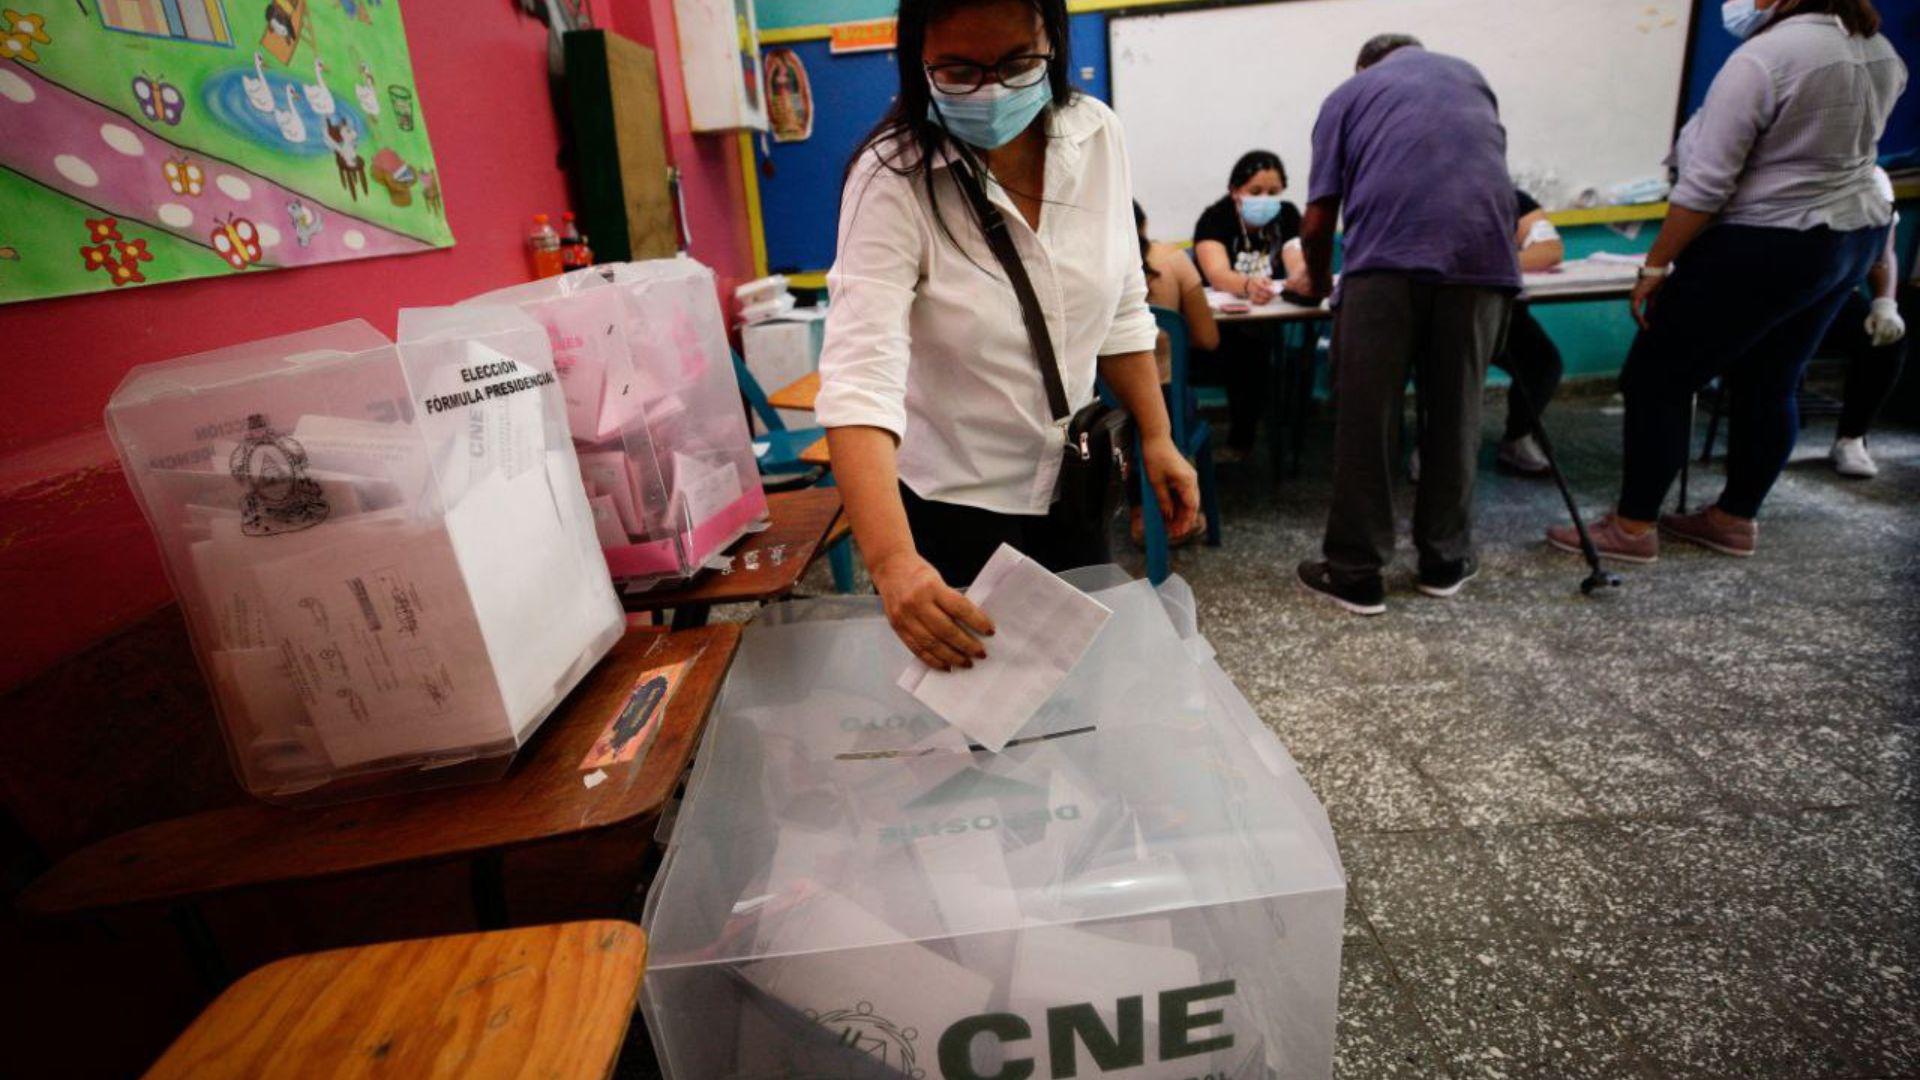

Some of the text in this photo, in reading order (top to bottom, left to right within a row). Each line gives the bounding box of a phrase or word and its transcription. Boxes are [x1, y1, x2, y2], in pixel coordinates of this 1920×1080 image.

[461, 357, 518, 383] ELECCIÓN
[425, 387, 484, 415] FÓRMULA
[937, 979, 1236, 1080] CNE
